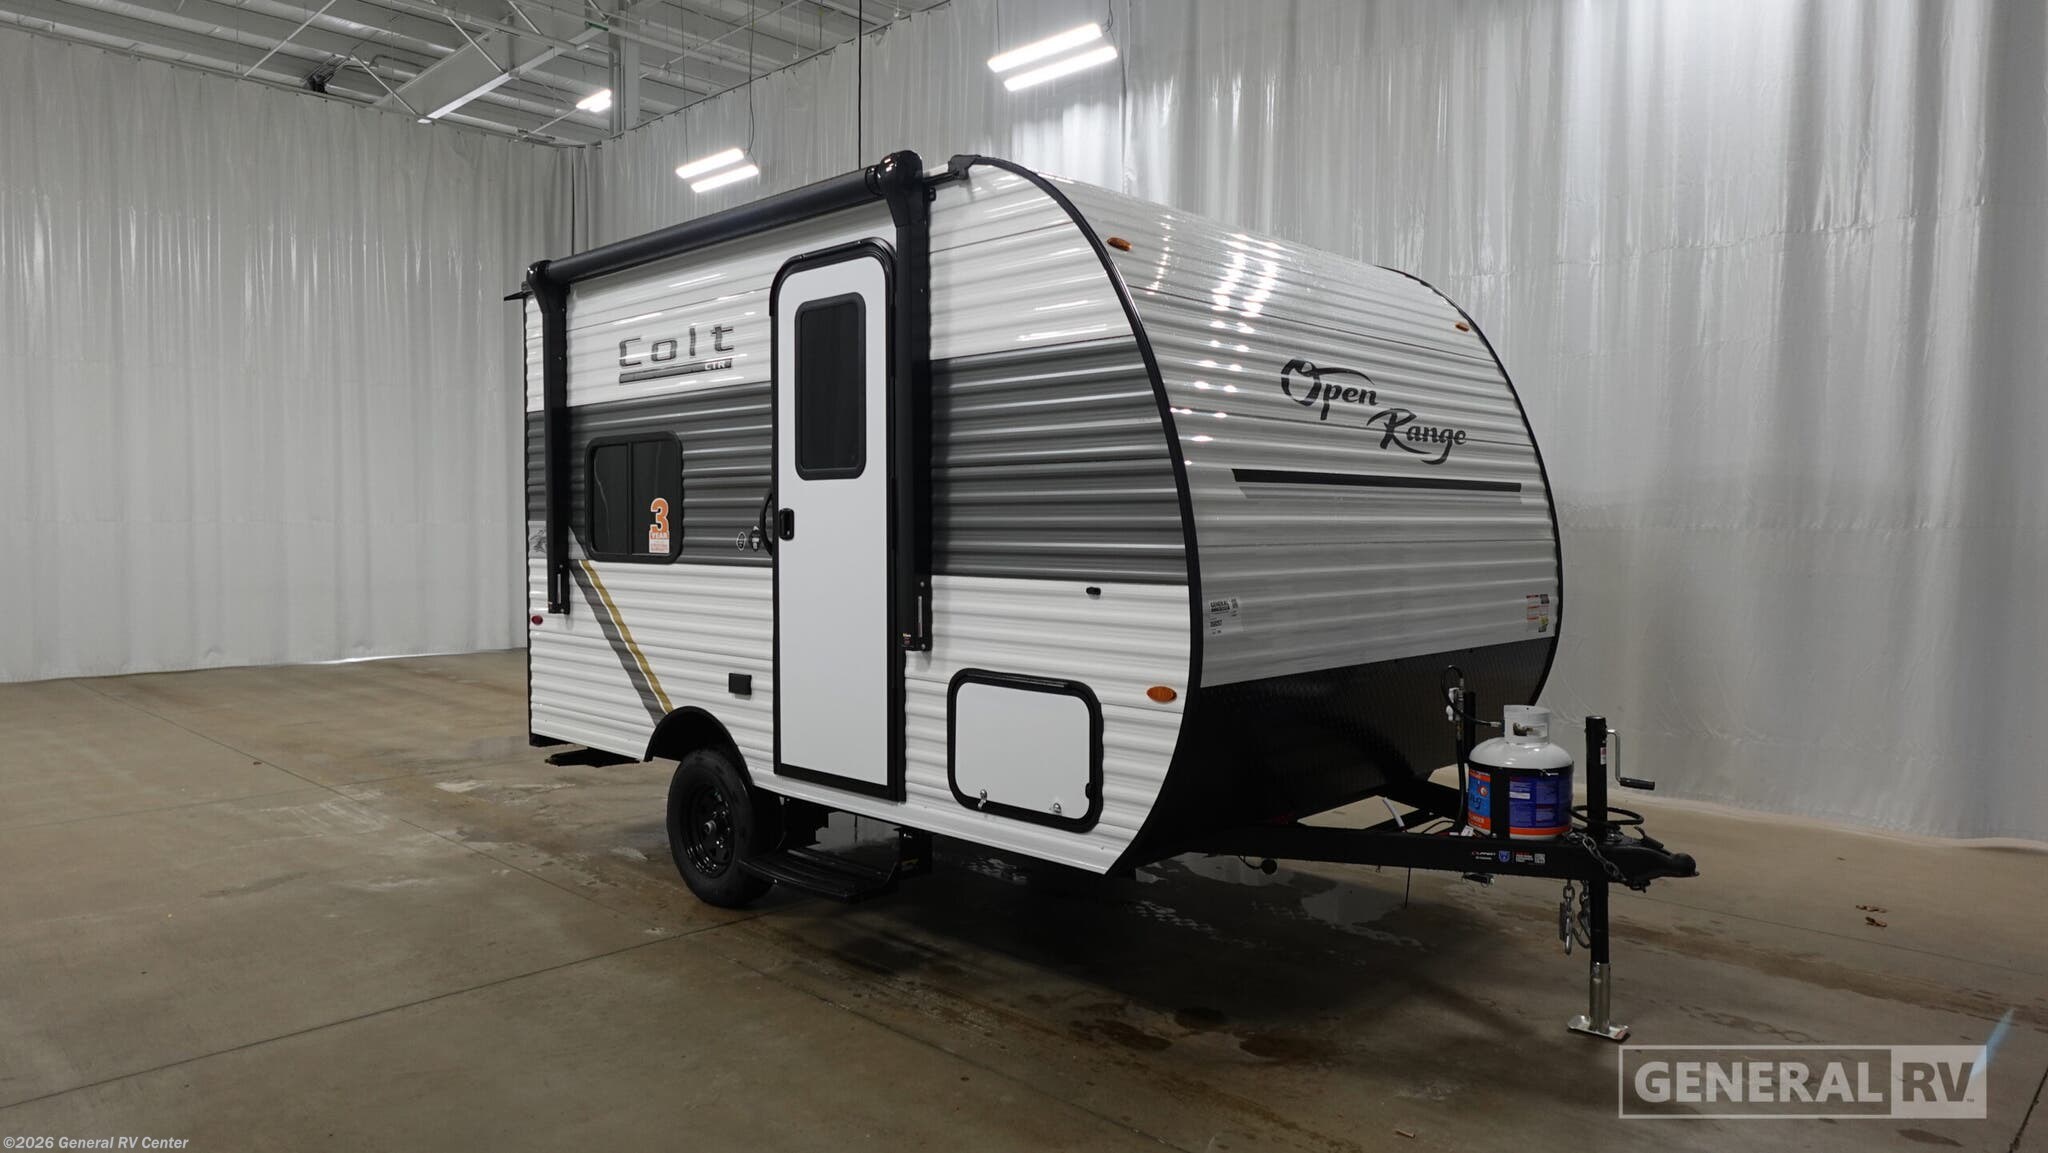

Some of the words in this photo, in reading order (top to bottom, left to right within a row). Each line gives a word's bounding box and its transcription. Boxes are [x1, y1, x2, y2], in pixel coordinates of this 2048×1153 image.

[619, 325, 734, 367] Colt
[704, 359, 726, 371] CTR
[1280, 358, 1379, 421] Open
[1366, 408, 1467, 465] Range
[650, 497, 669, 532] 3
